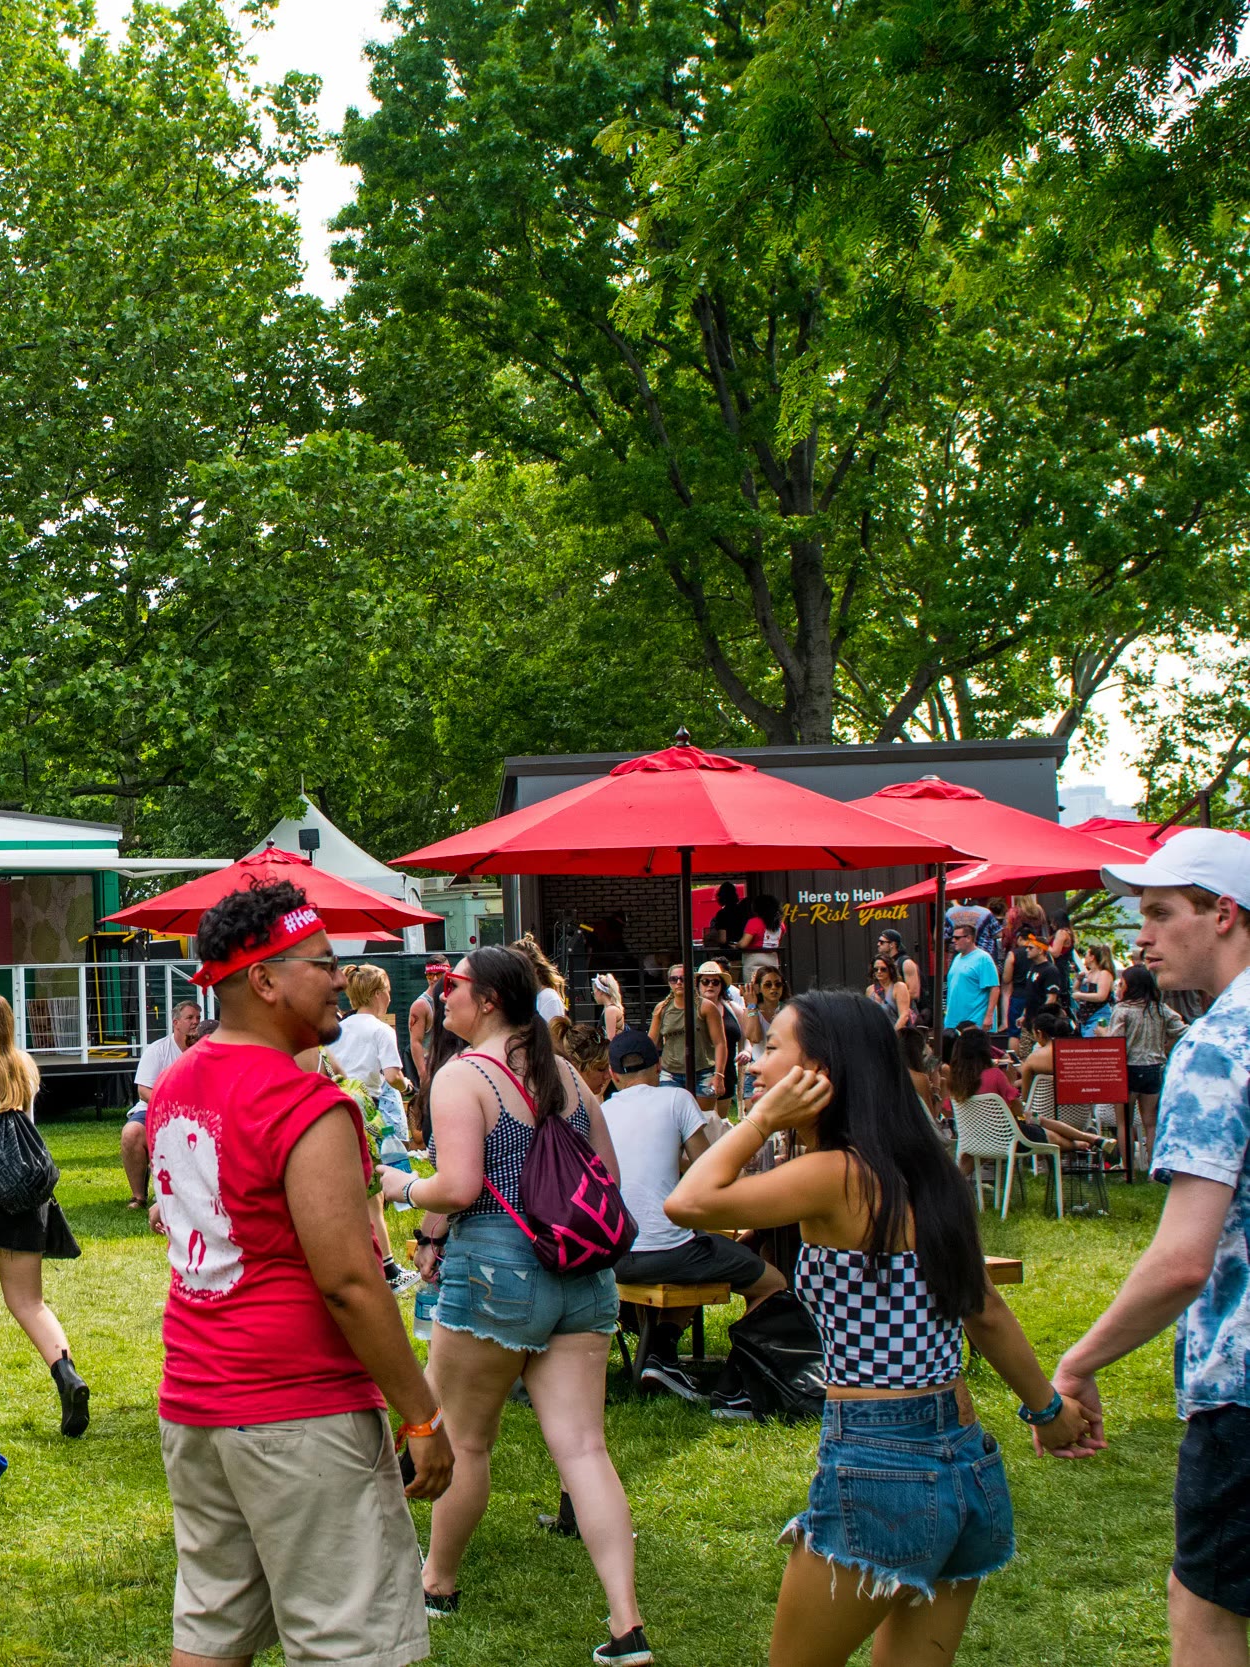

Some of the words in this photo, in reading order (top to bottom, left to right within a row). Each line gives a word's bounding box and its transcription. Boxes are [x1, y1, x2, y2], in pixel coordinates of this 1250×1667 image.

[798, 890, 831, 903] Here
[834, 891, 850, 902] to
[852, 888, 885, 902] Help
[858, 902, 909, 926] Youth
